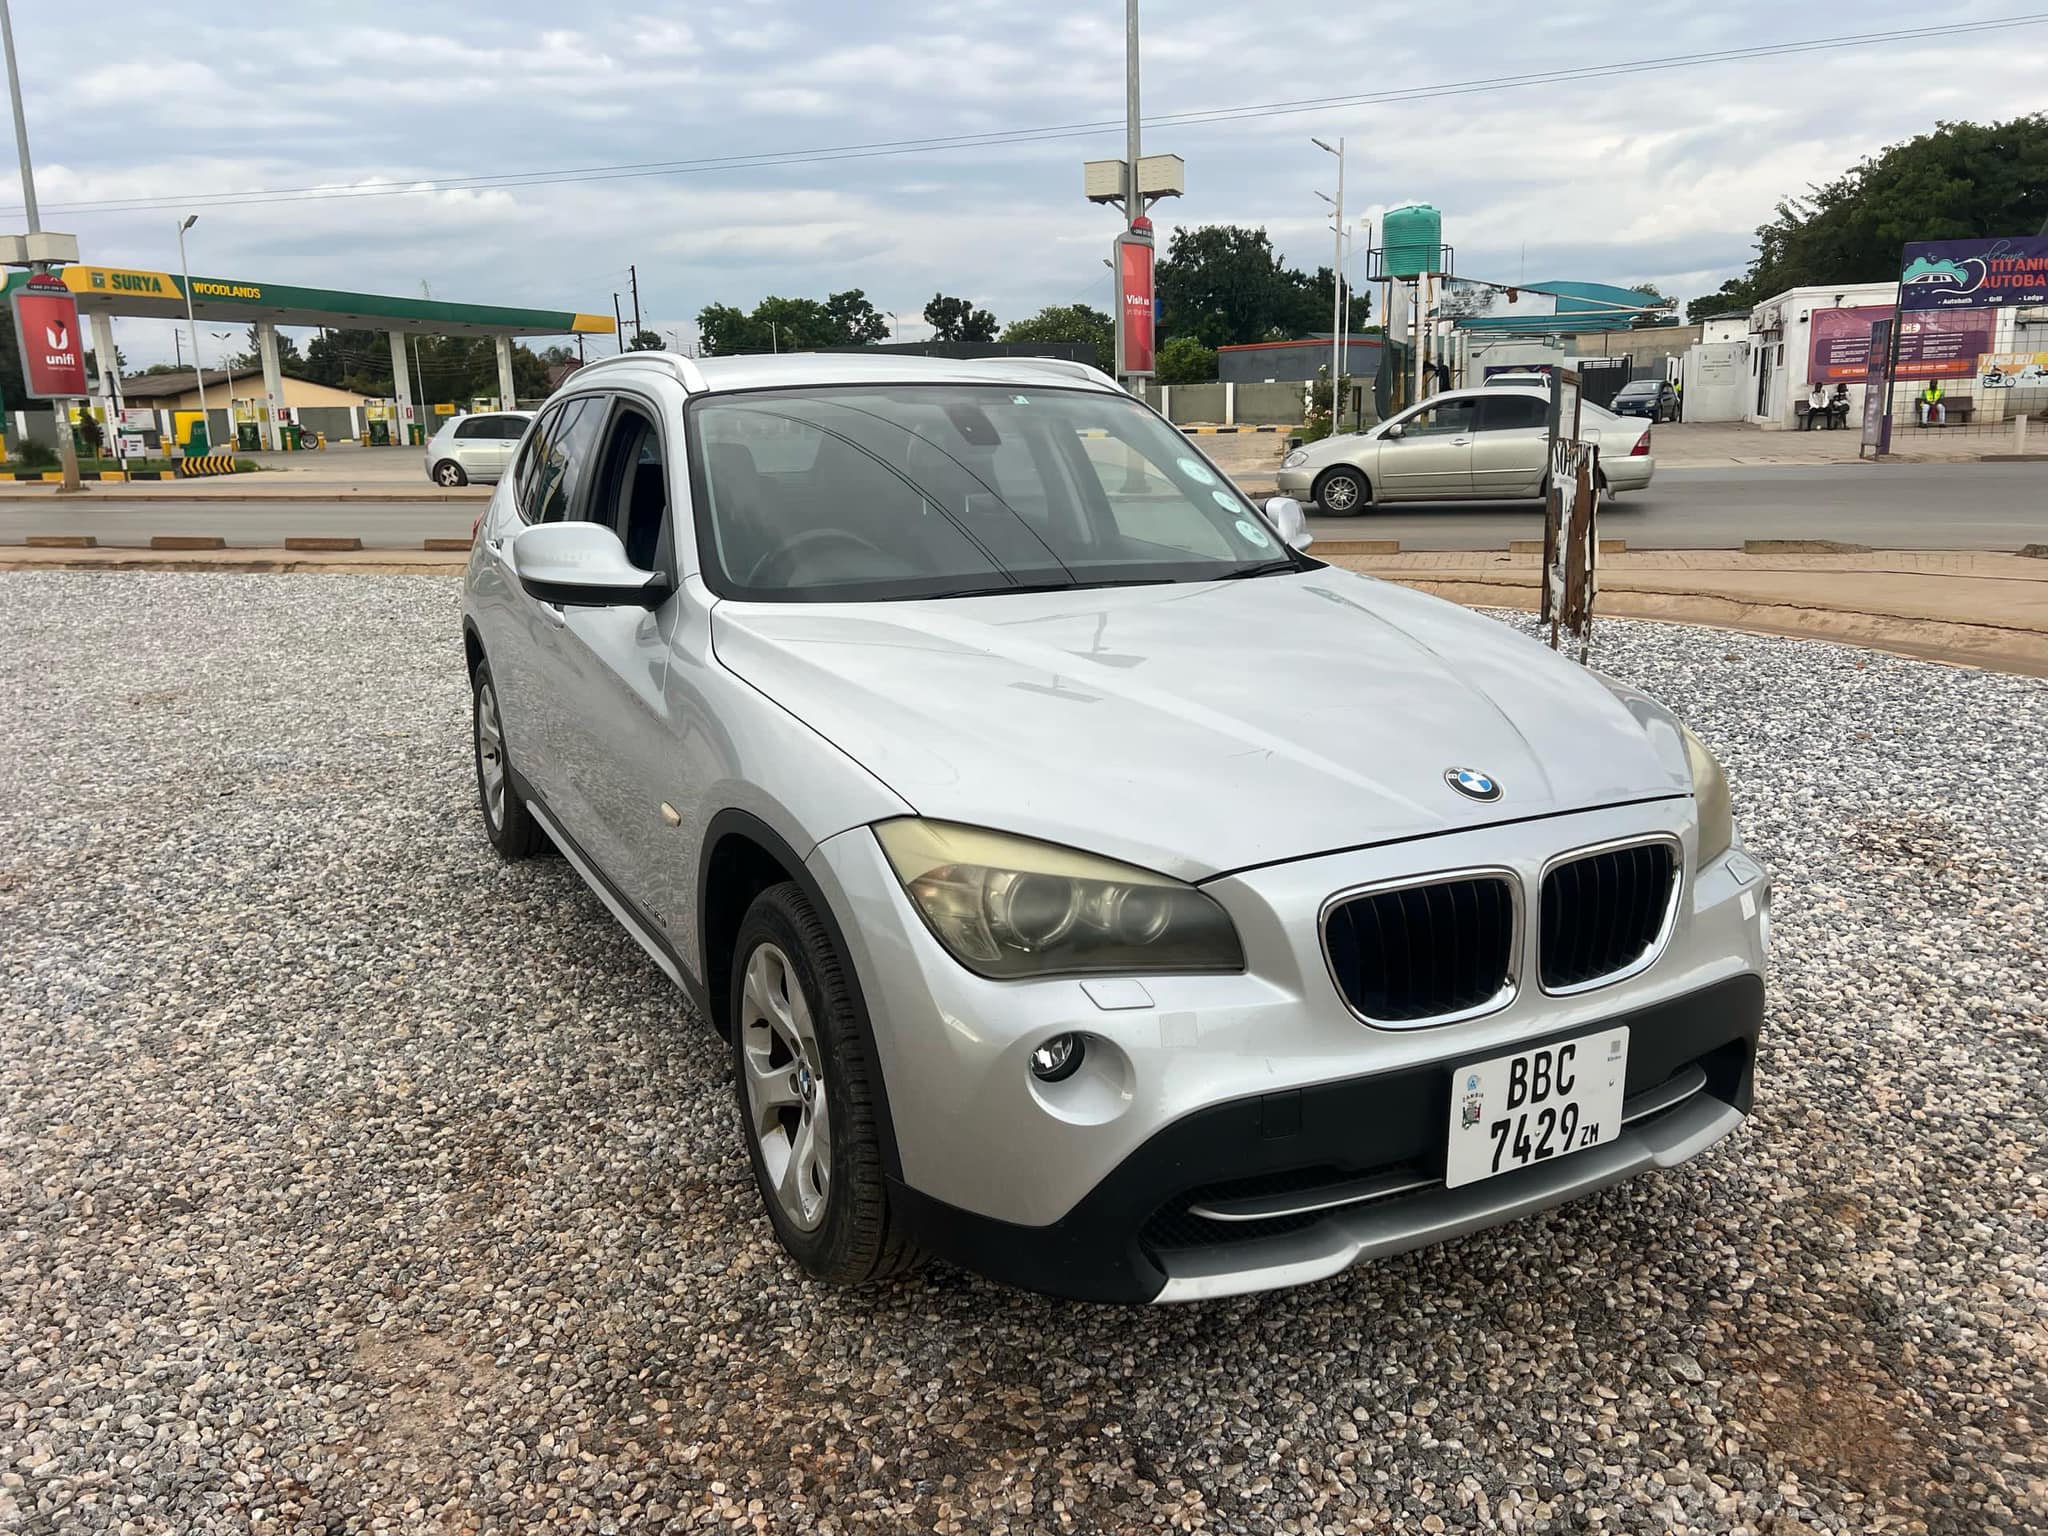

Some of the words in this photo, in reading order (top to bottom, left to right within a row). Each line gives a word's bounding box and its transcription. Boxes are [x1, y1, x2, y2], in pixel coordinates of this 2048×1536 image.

[111, 273, 163, 292] SURYA
[1979, 273, 2047, 288] AUTOBA
[192, 281, 261, 298] WOODLANDS
[1126, 294, 1143, 305] Visit
[45, 353, 75, 365] unifi
[1507, 1043, 1576, 1110] BBC
[1491, 1102, 1579, 1173] 7429
[1580, 1122, 1599, 1146] ZM
